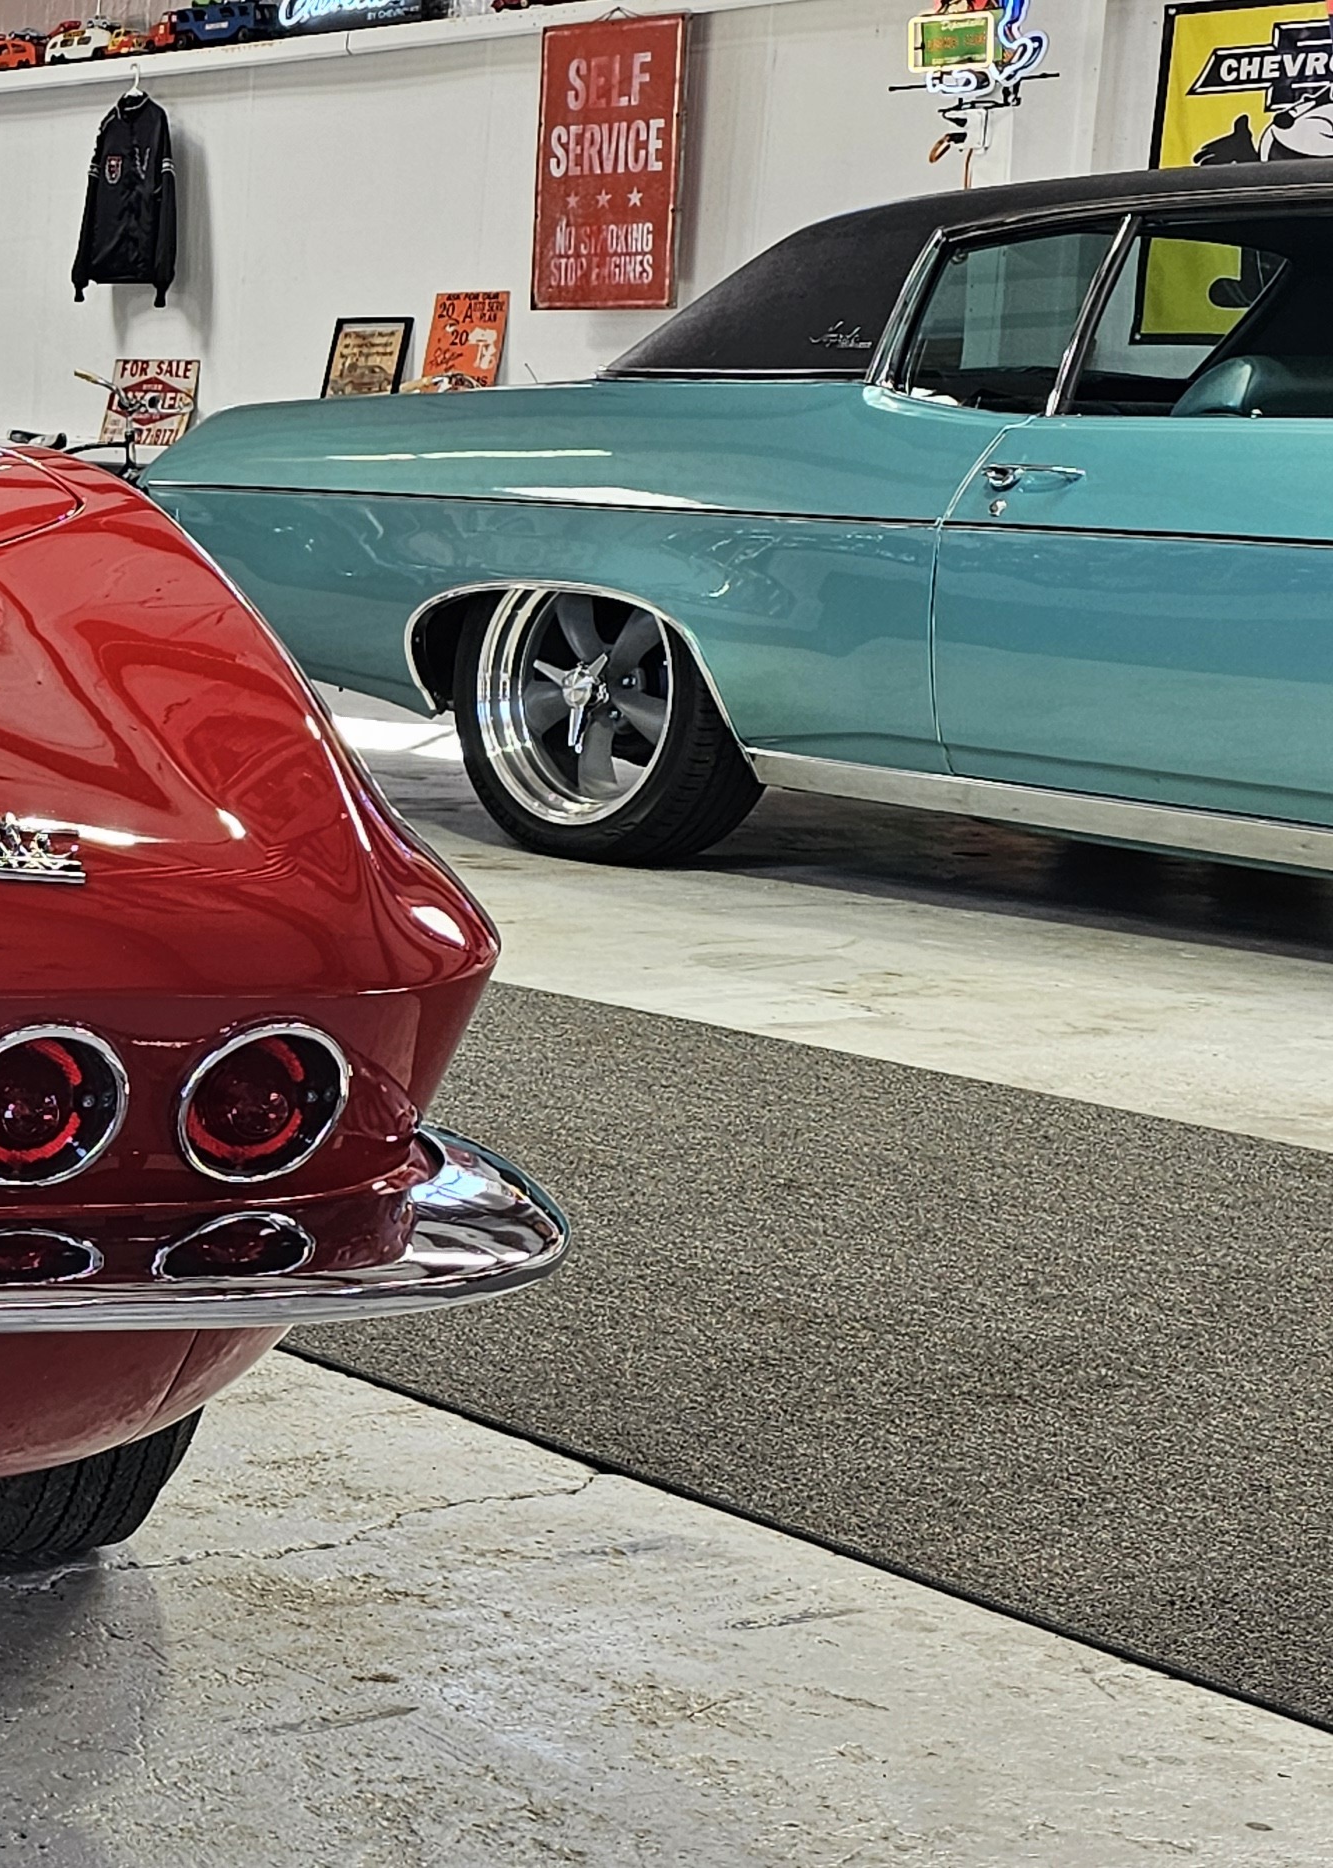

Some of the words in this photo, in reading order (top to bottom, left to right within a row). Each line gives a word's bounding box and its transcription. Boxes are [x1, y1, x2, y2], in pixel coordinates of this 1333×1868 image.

[566, 51, 652, 111] SELF
[549, 118, 666, 178] SERVICE
[555, 220, 575, 256] NO
[580, 222, 654, 255] SMOKING
[550, 257, 587, 288] STOP
[591, 254, 654, 286] ENGINES
[120, 359, 150, 379] FOR
[156, 359, 193, 380] SALE
